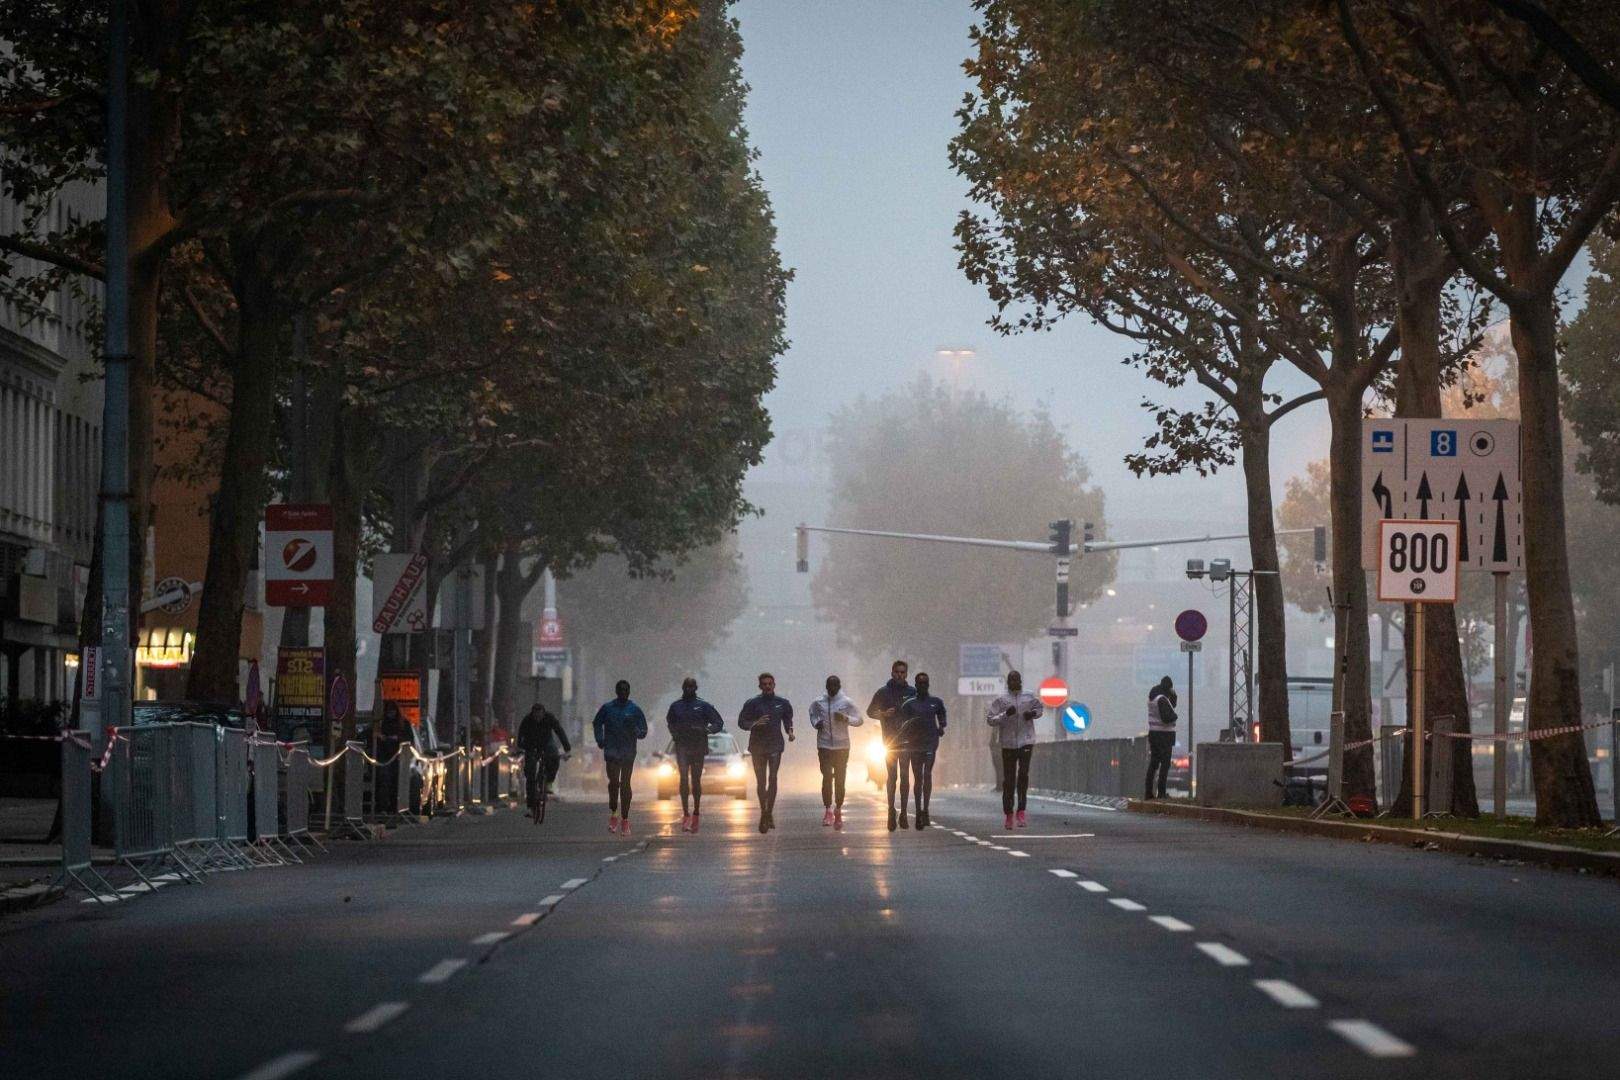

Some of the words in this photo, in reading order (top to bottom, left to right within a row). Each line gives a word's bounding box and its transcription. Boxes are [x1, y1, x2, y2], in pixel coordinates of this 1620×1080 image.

[1437, 432, 1451, 455] 8
[1390, 531, 1448, 574] 800
[374, 553, 427, 632] BAUHAUS
